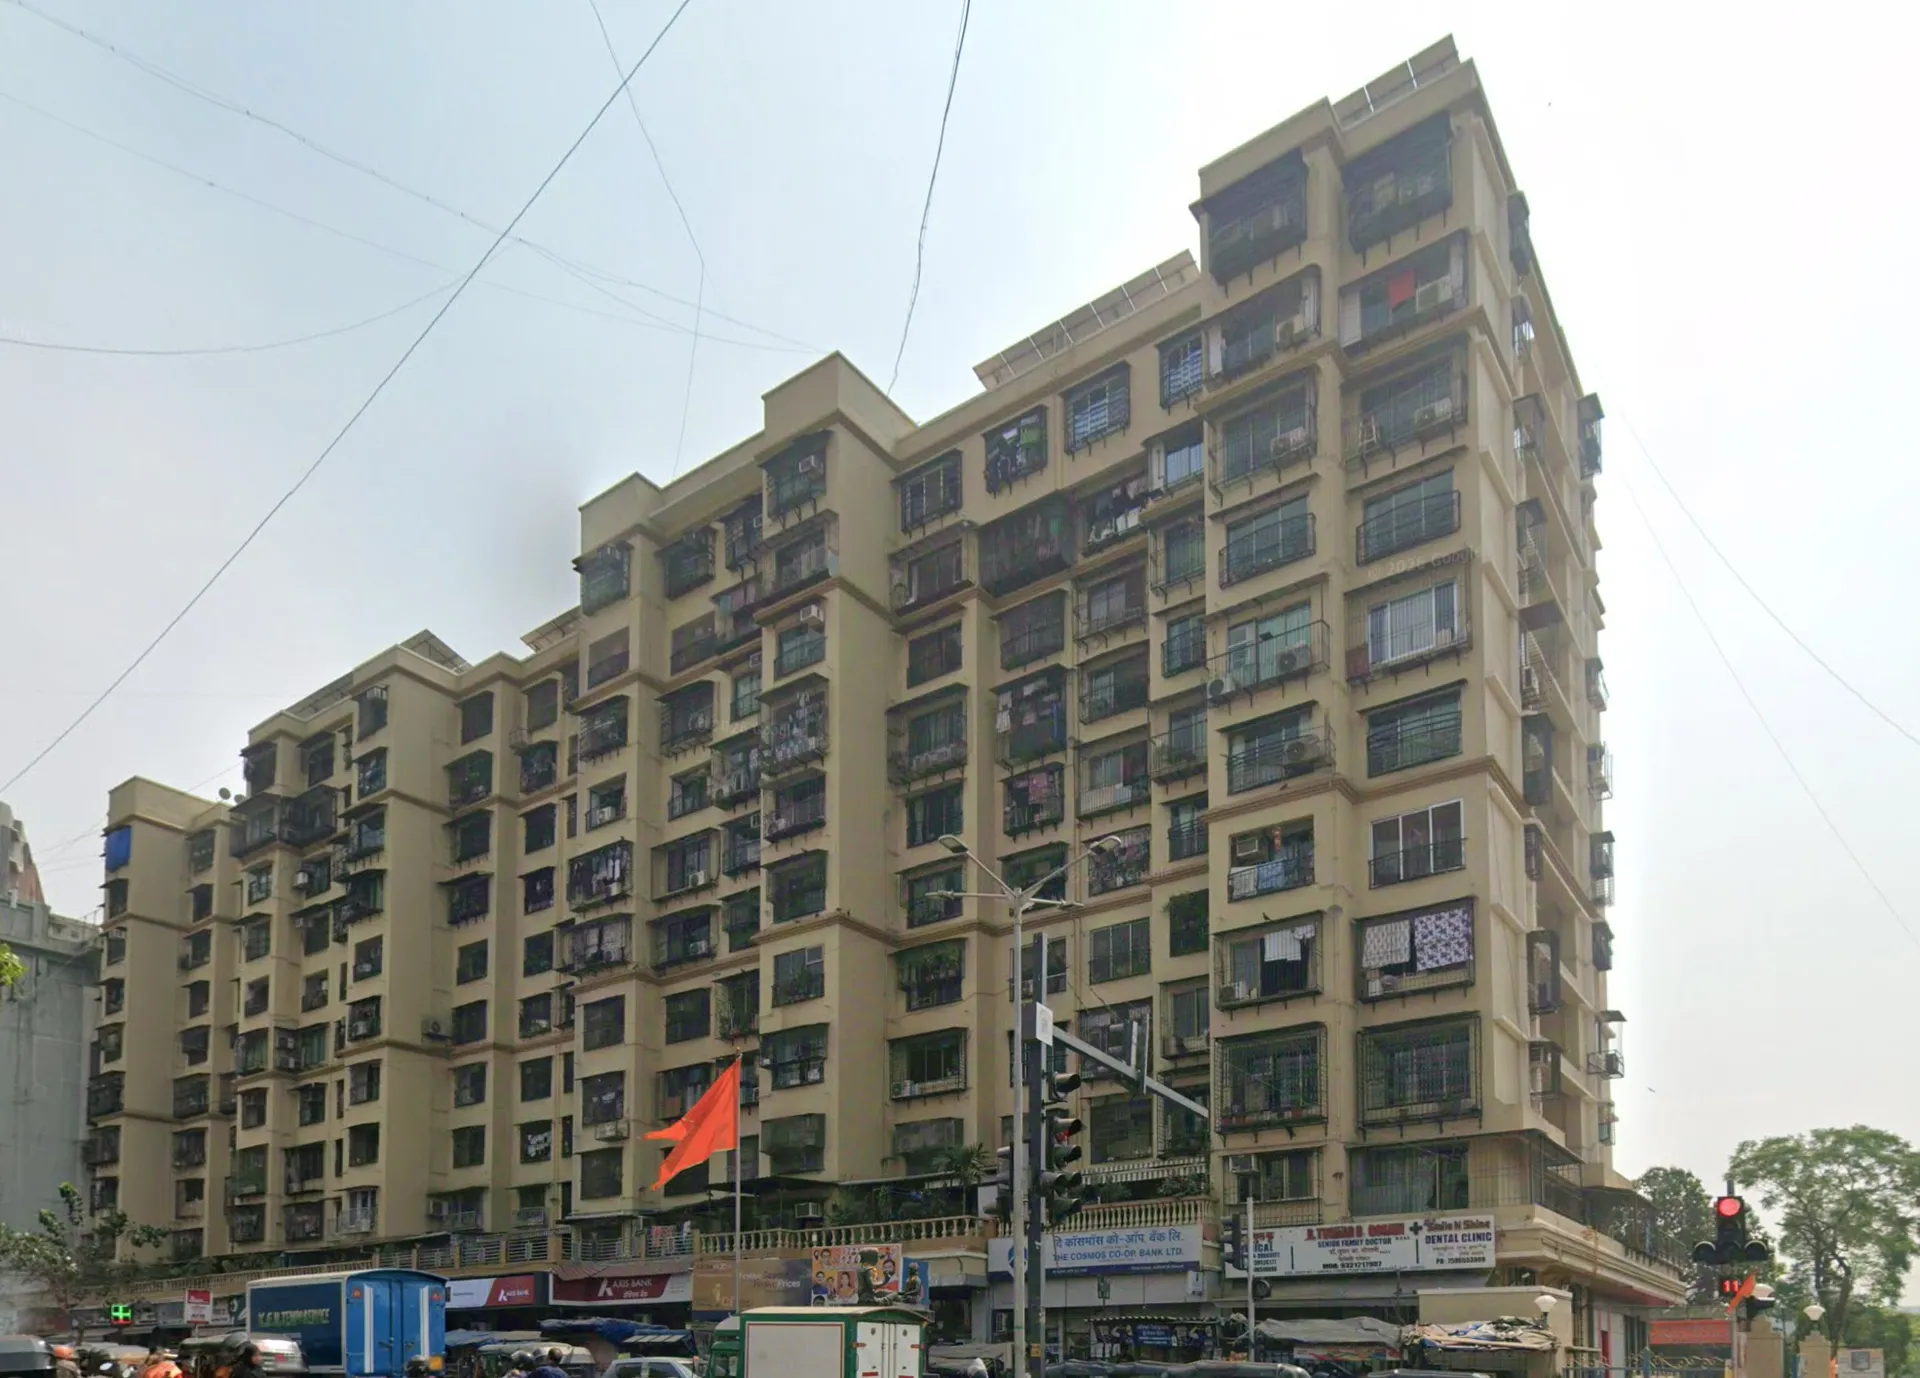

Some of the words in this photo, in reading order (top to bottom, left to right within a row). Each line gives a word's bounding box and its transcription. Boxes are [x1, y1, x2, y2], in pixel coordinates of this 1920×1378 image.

[1317, 1240, 1340, 1248] SENIOR
[1365, 1237, 1392, 1246] DOCTOR
[1425, 1233, 1459, 1244] DENTAL
[1461, 1231, 1492, 1243] CLINIC
[1053, 1253, 1068, 1261] THE
[1070, 1251, 1106, 1260] COSMOS
[1139, 1248, 1163, 1257] BANK
[612, 1280, 630, 1289] AXIS
[630, 1278, 652, 1288] BANK
[777, 1279, 801, 1288] Prices
[1723, 1279, 1738, 1293] 11
